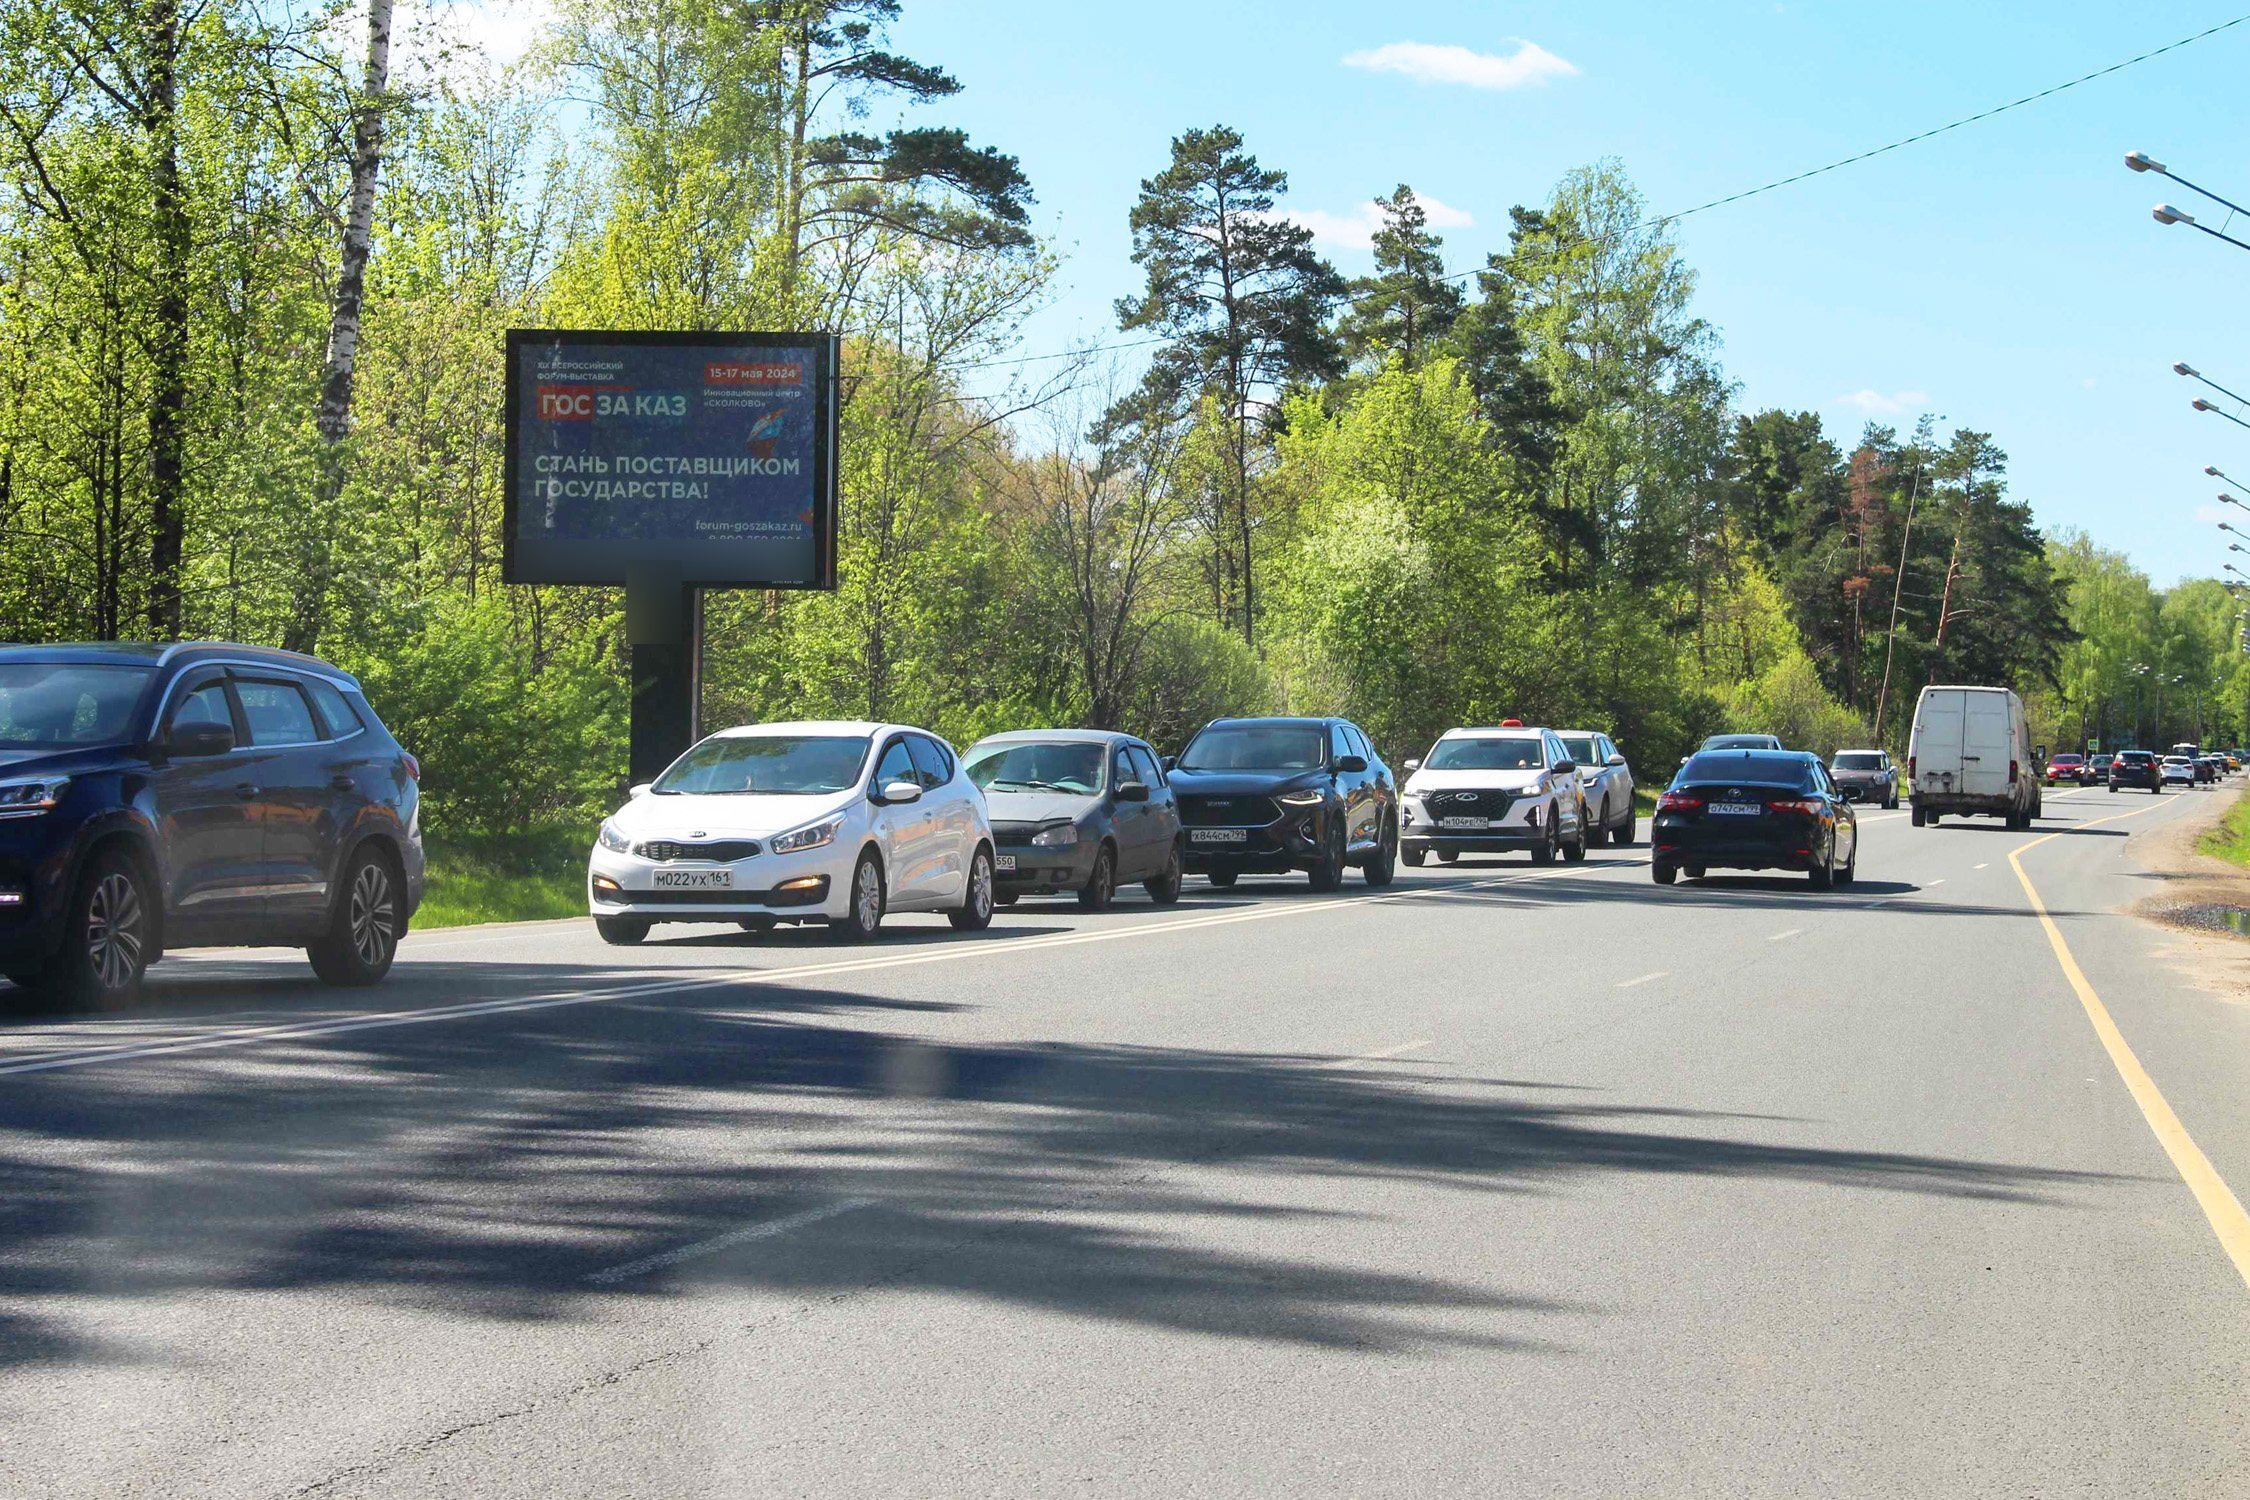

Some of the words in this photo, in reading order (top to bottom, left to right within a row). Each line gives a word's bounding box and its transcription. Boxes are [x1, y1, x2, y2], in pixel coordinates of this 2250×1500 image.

[551, 360, 624, 370] ВСЕРОССИЙСКИЙ
[537, 373, 615, 381] ФОРУМ-ВЫСТАВКА
[711, 368, 738, 378] 15-17
[741, 370, 763, 378] мая
[766, 369, 796, 378] 2024
[704, 389, 773, 397] Инновационный
[775, 391, 801, 399] центр
[534, 455, 609, 474] СТАНЬ
[615, 456, 800, 478] ПОСТАВЩИКОМ
[534, 480, 709, 501] ГОСУДАРСТВА!
[696, 520, 802, 532] forum-goszakaz.ru
[709, 872, 730, 883] 161
